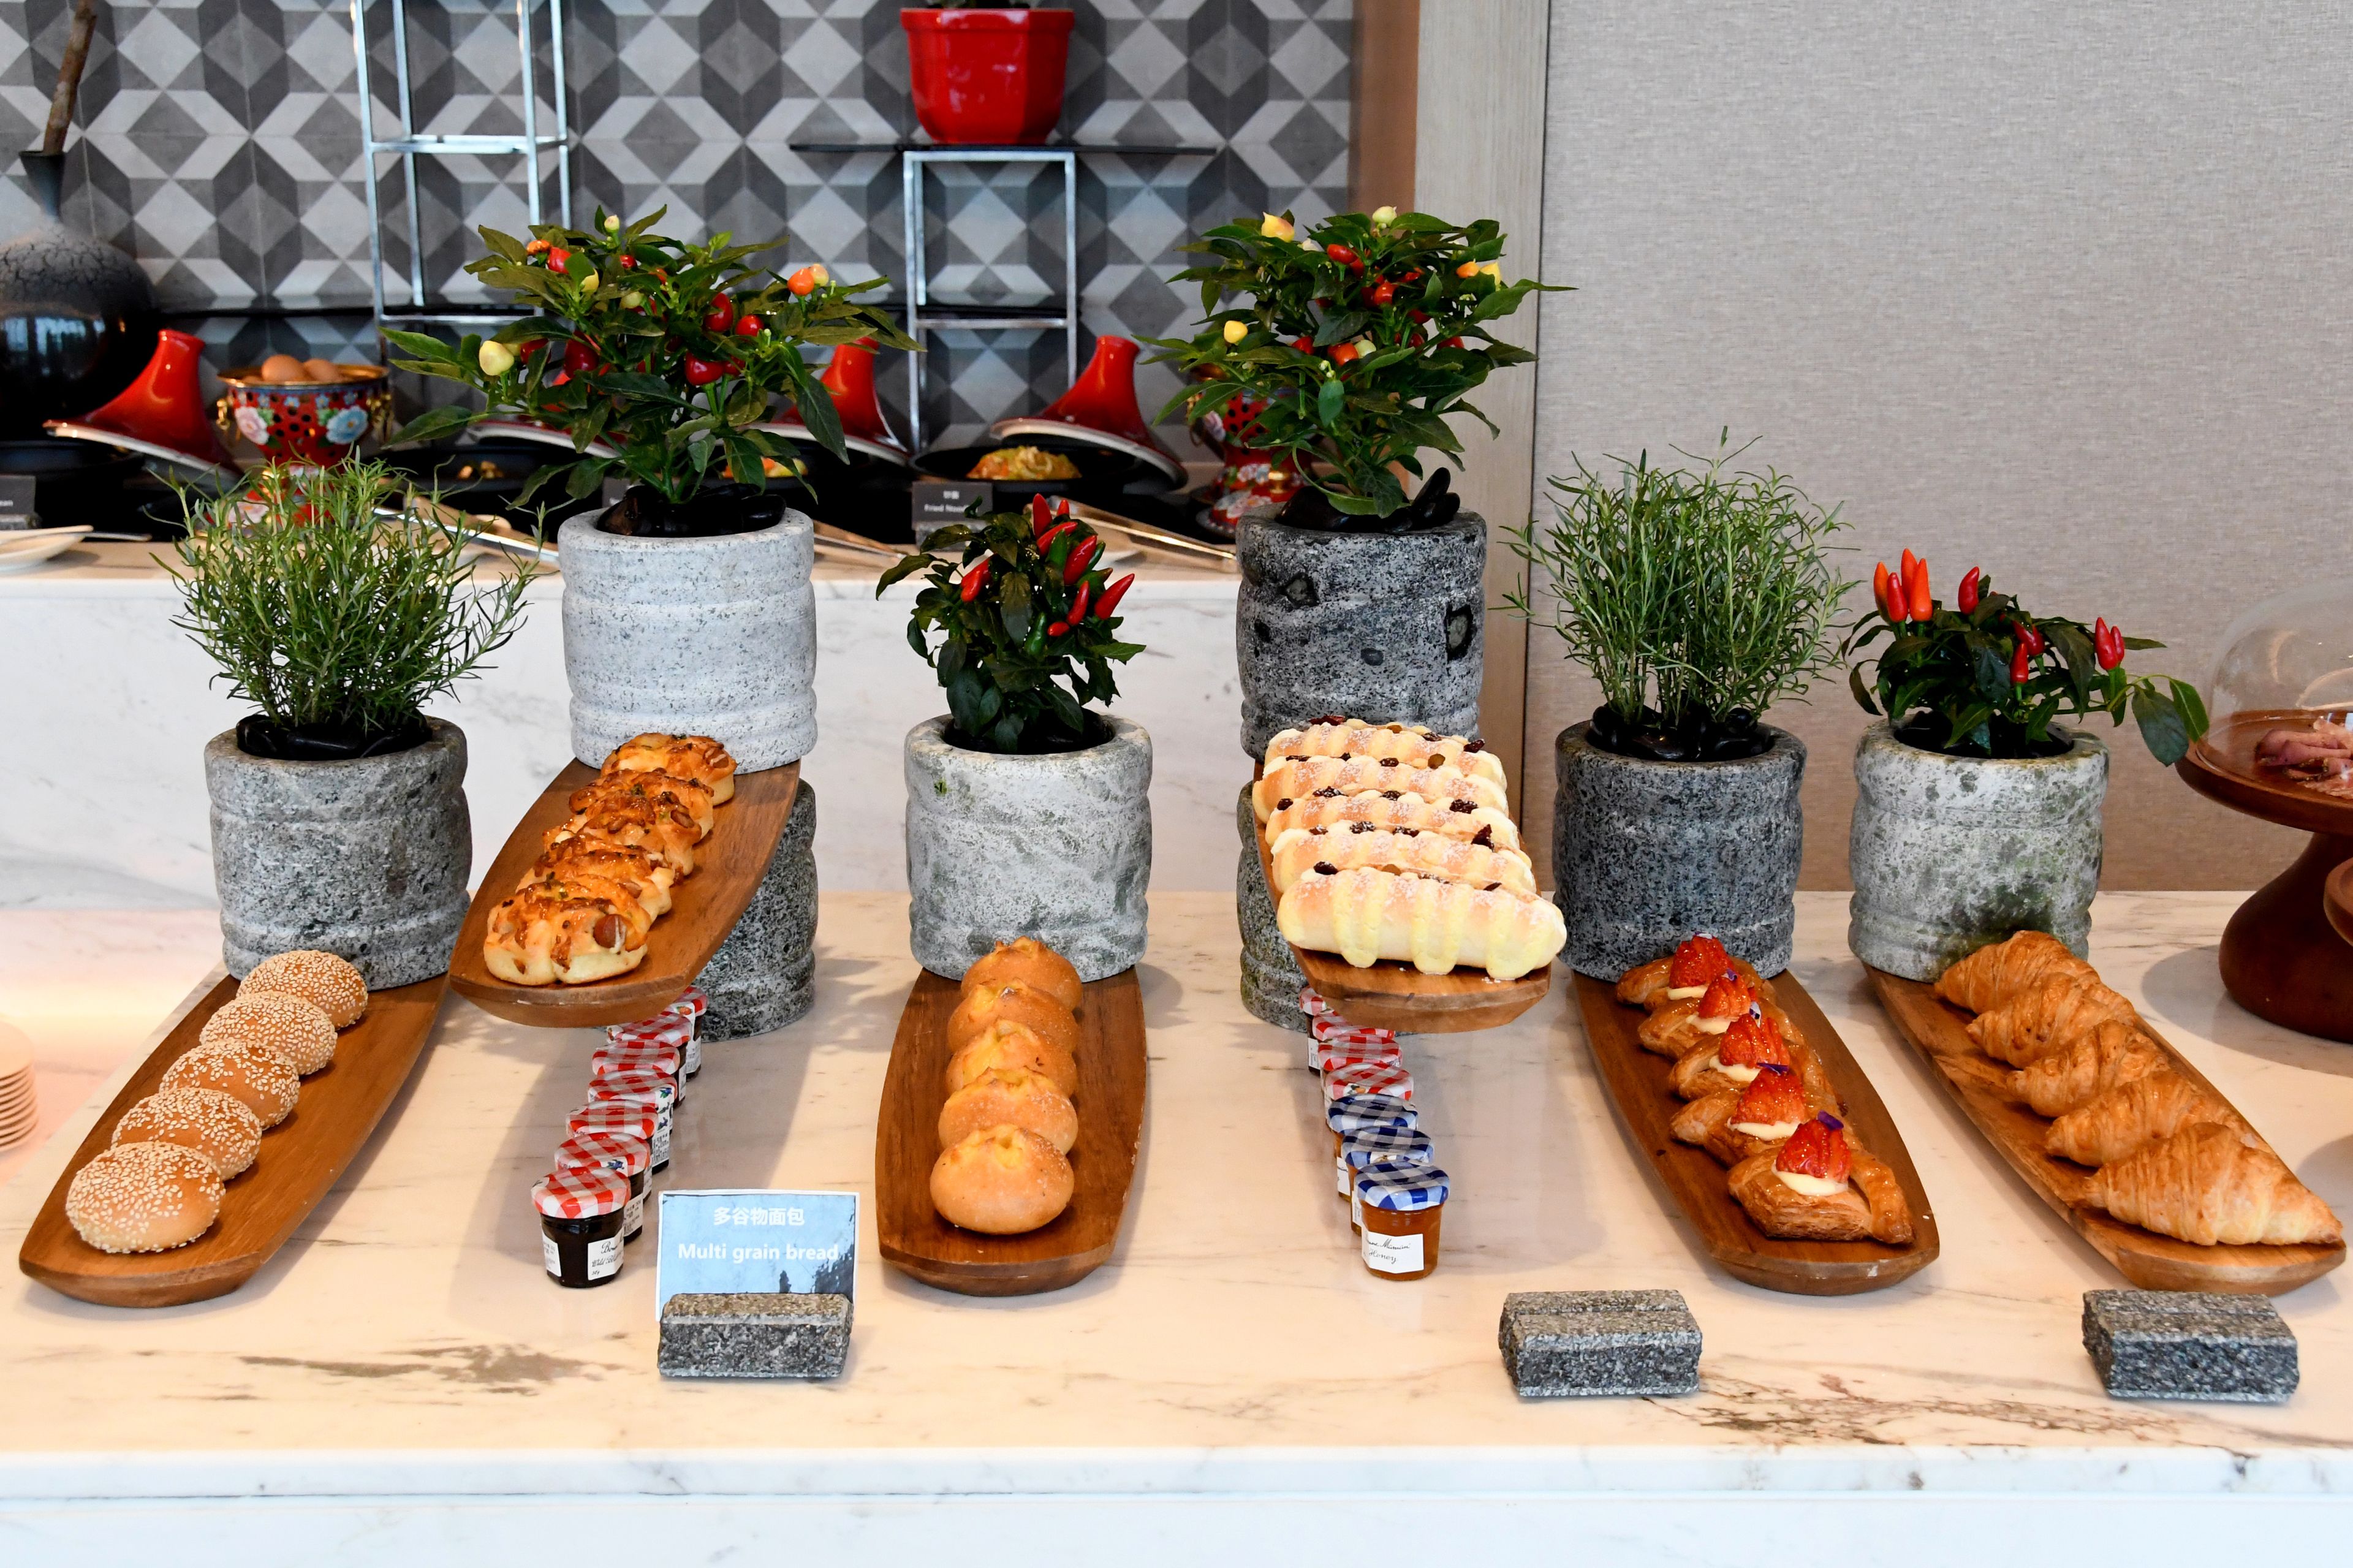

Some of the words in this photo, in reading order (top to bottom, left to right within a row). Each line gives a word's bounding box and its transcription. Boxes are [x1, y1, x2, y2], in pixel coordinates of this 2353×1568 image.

[713, 1206, 806, 1226] 多谷物面包
[678, 1243, 726, 1259] Multi
[733, 1243, 780, 1263] grain
[786, 1243, 839, 1260] bread
[1369, 1249, 1396, 1265] Honey
